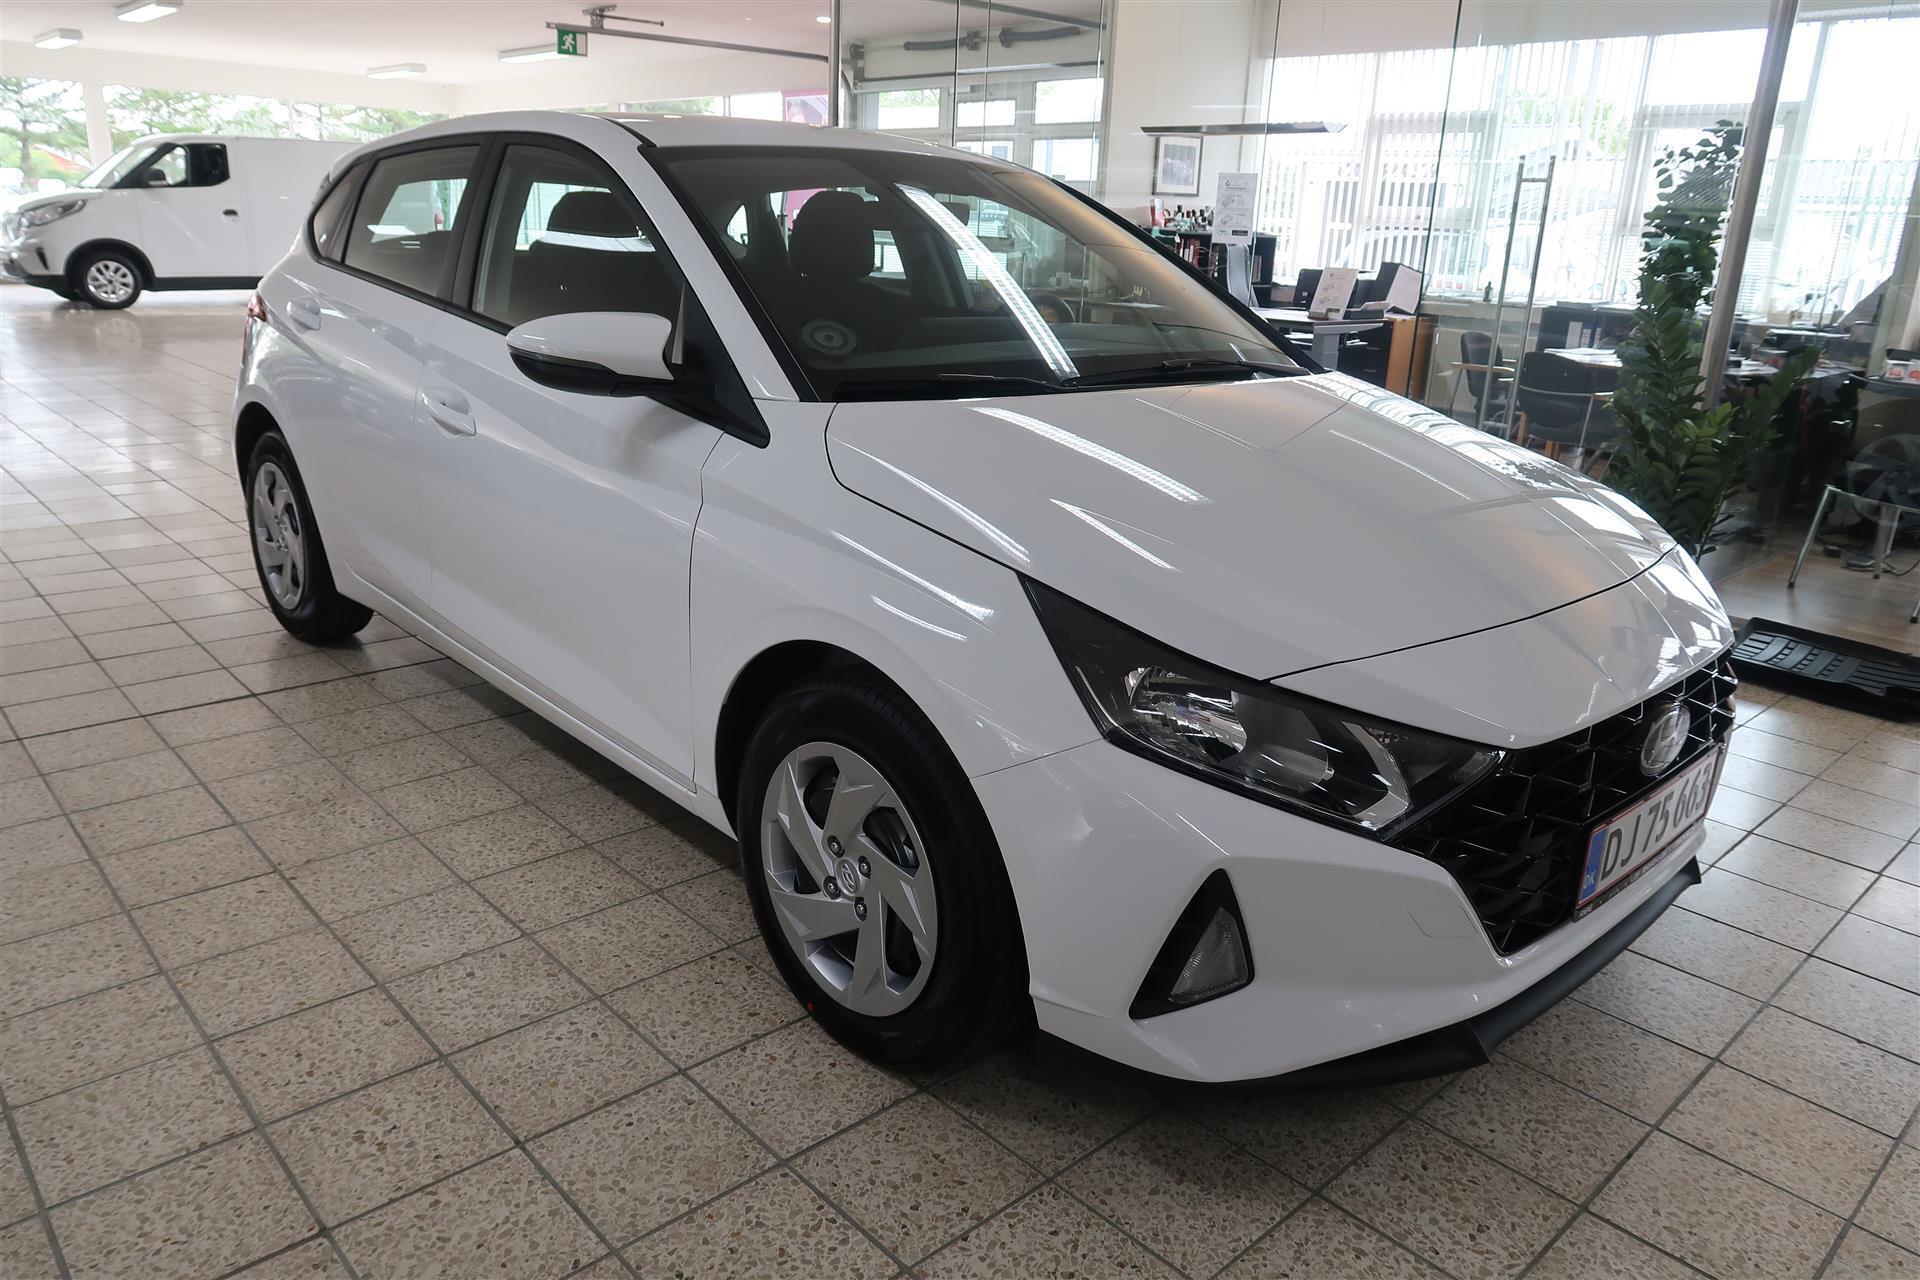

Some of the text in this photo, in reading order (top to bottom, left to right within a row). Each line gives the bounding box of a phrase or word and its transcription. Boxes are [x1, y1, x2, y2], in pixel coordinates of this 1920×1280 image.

[1601, 814, 1642, 881] DJ
[1642, 790, 1675, 853] 75
[1673, 763, 1713, 828] 663
[1583, 869, 1597, 889] DK
